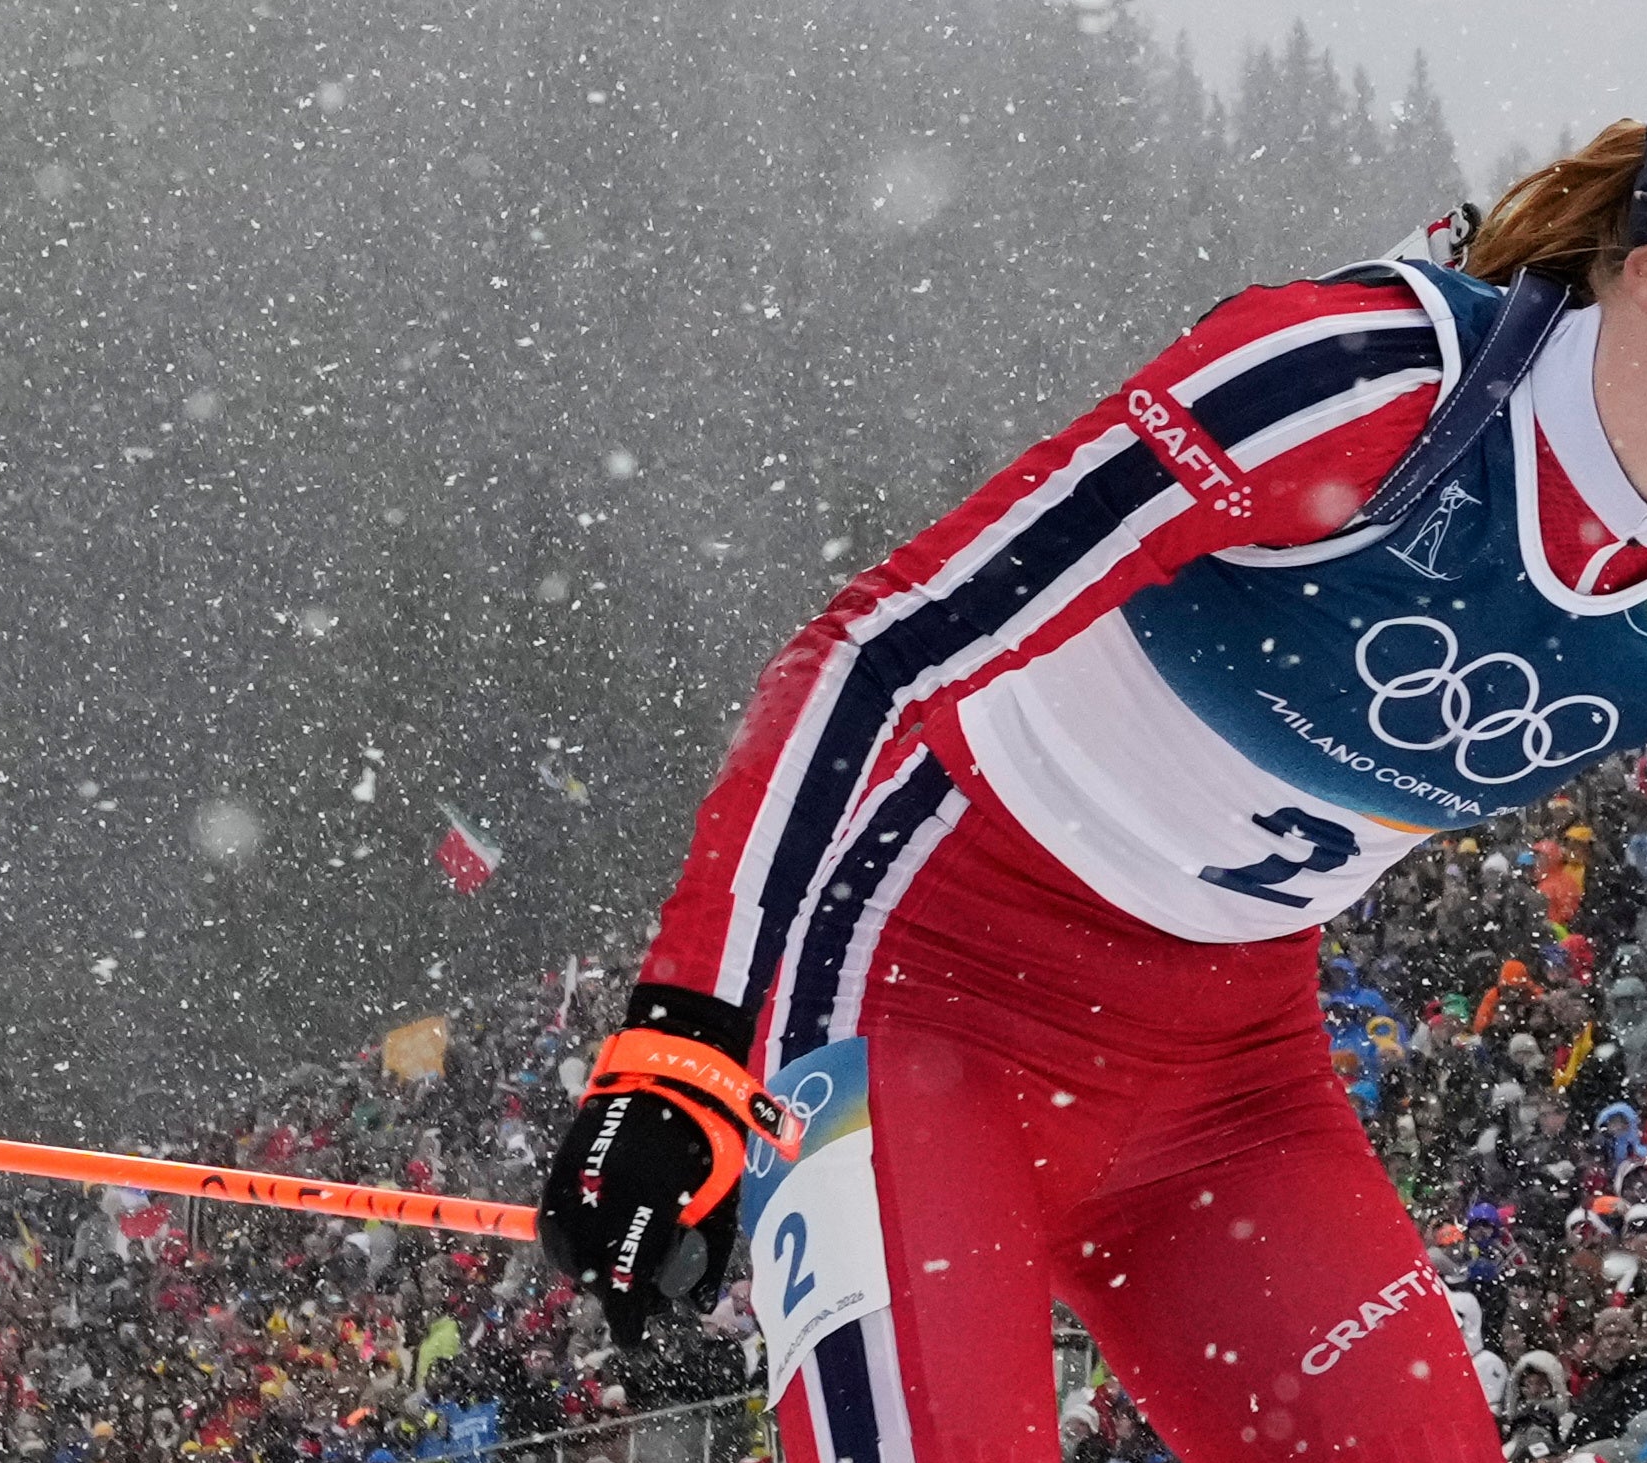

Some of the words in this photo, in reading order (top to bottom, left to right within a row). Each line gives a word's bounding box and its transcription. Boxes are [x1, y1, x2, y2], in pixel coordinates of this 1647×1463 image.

[1128, 389, 1233, 491] CRAFT
[1255, 689, 1376, 772] MILANO
[1374, 767, 1482, 816] CORTINA
[1198, 806, 1361, 909] 2
[773, 1211, 815, 1320] 2
[1301, 1270, 1427, 1375] CRAFT
